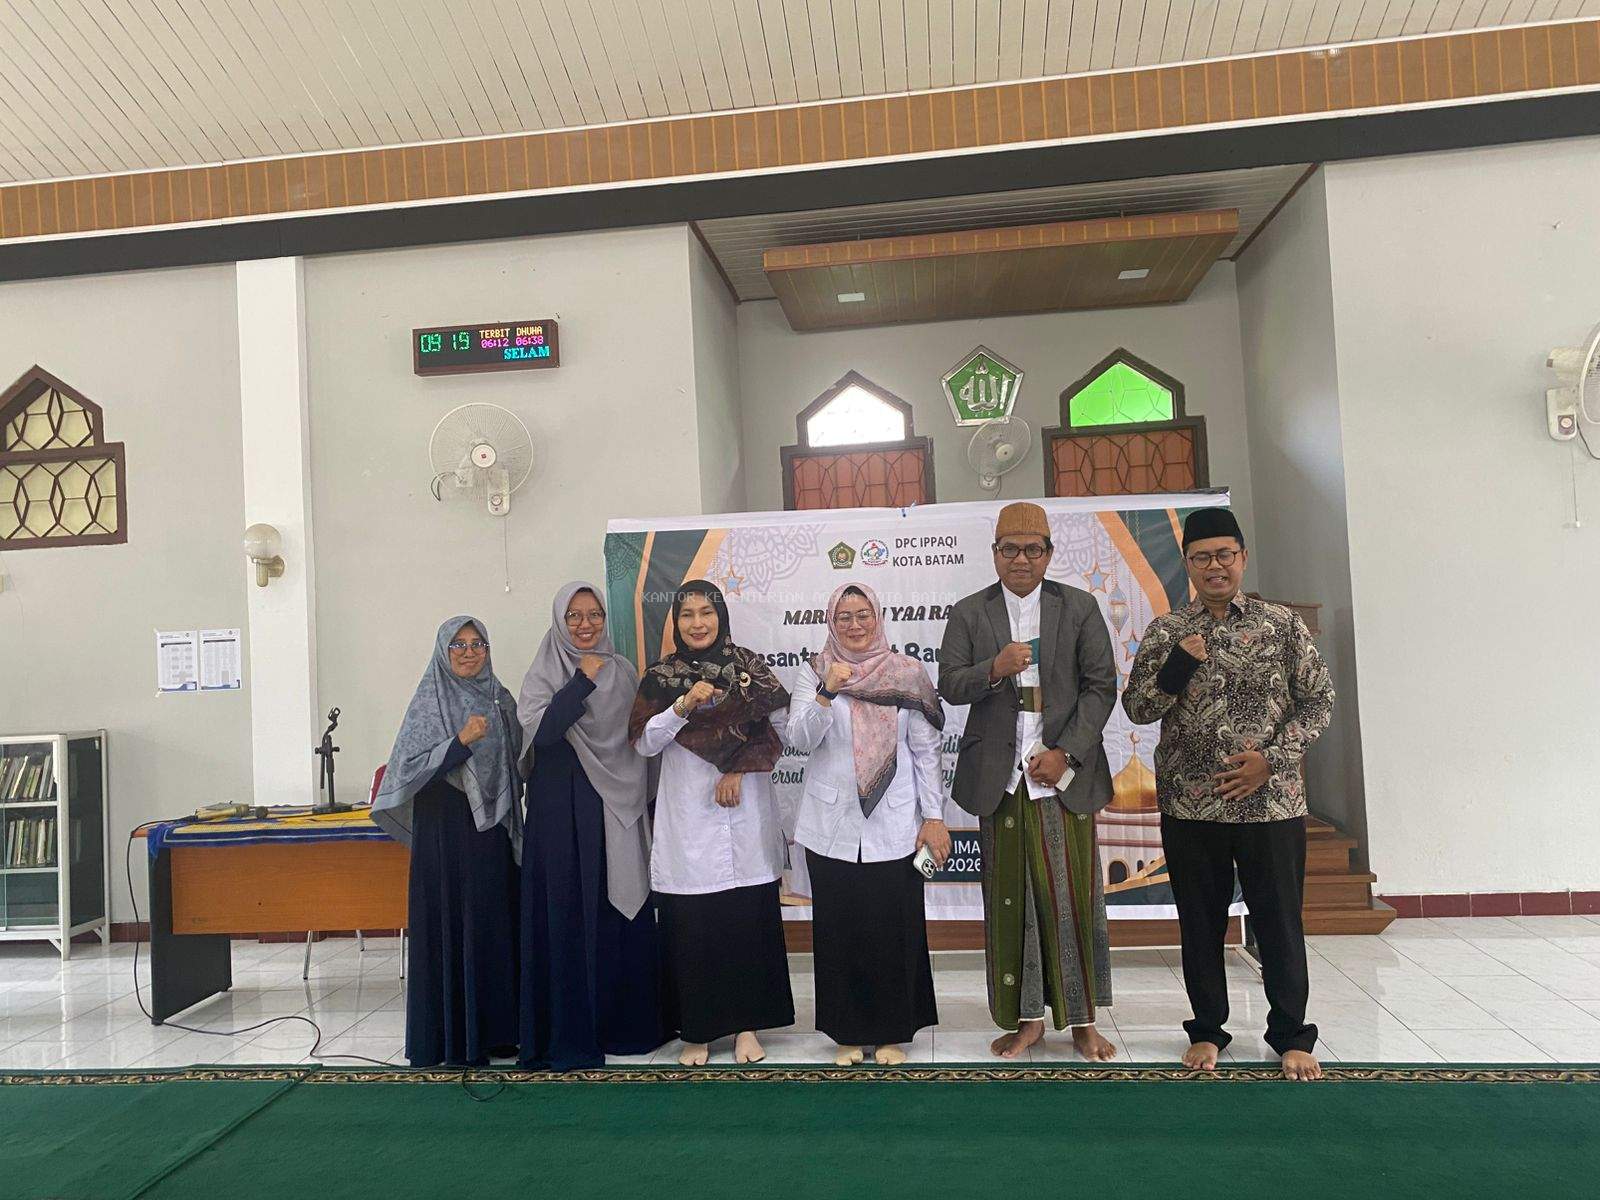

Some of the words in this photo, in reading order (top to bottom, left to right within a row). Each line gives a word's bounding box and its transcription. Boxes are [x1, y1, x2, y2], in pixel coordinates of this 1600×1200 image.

[479, 328, 510, 339] TERBIT
[516, 326, 543, 336] DHUHA
[453, 331, 470, 350] 19
[481, 338, 510, 348] 06:12
[516, 335, 544, 346] 06:38
[504, 345, 550, 360] SELAM
[895, 537, 917, 549] DPC
[920, 535, 957, 548] IPPAQI
[892, 555, 923, 567] KOTA
[925, 553, 964, 566] BATAM
[890, 605, 925, 622] YAA
